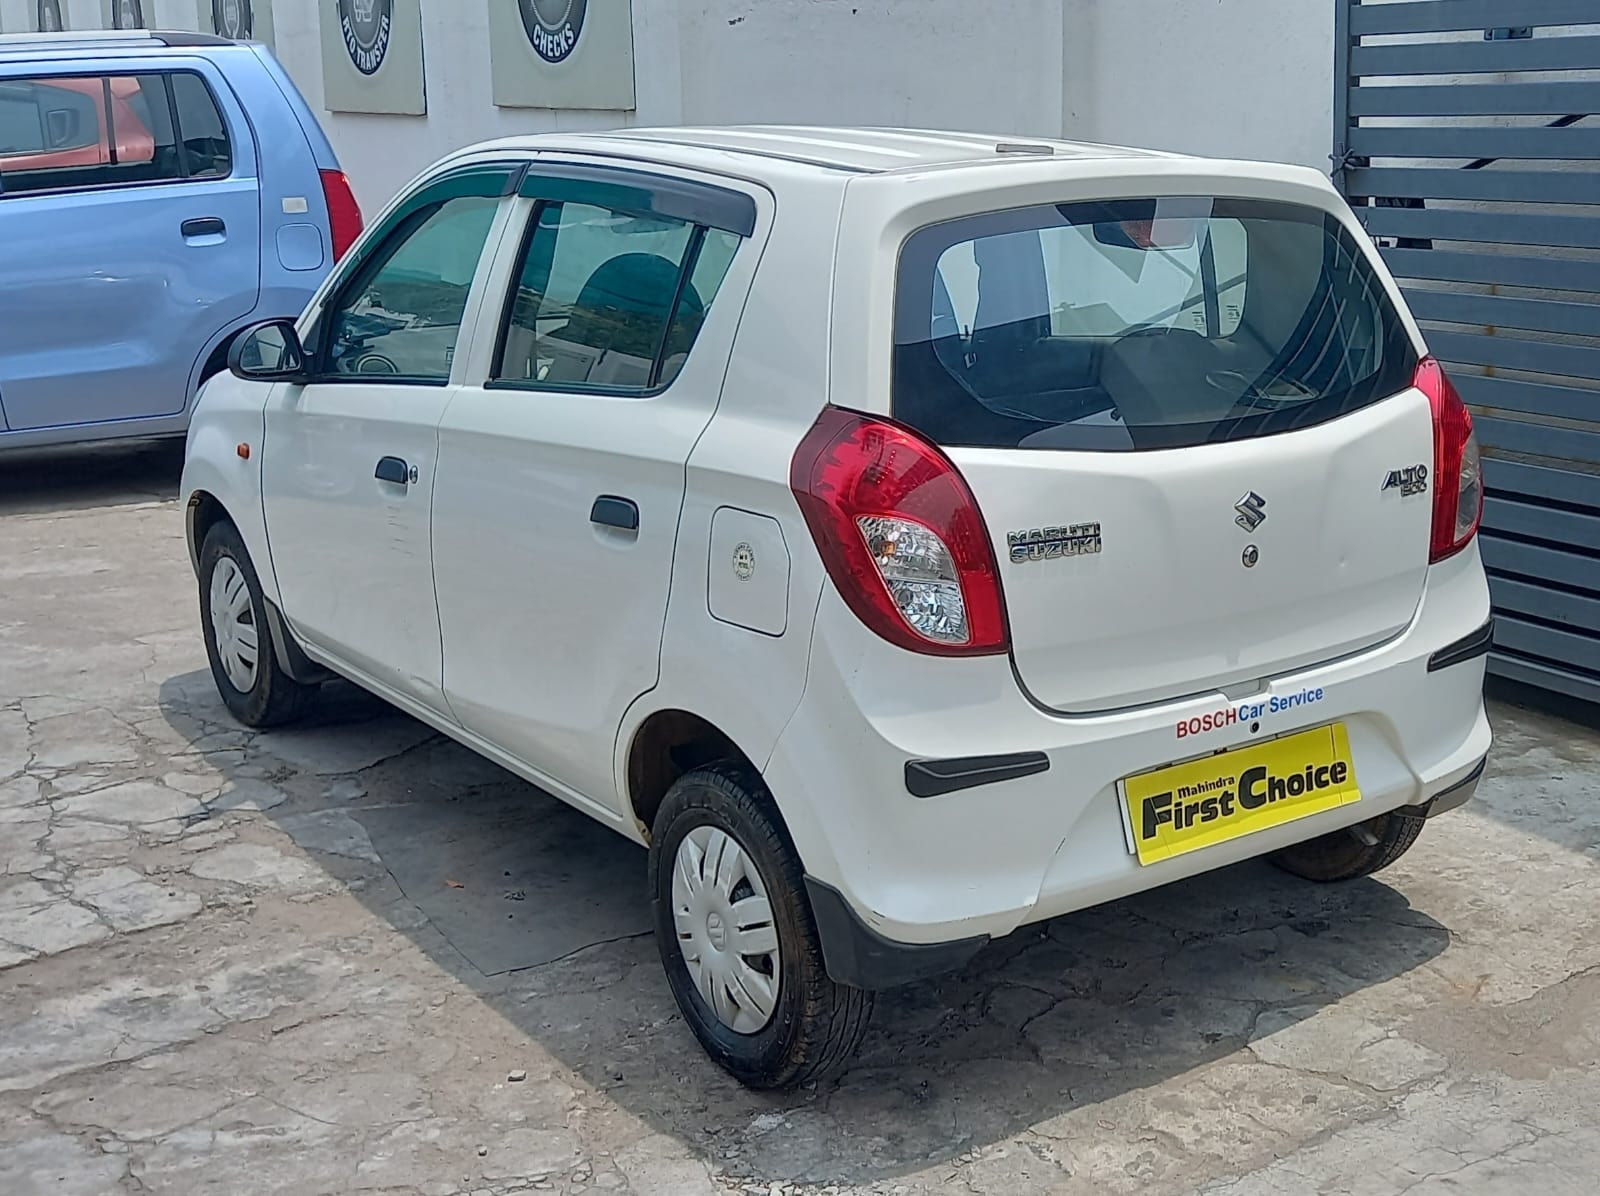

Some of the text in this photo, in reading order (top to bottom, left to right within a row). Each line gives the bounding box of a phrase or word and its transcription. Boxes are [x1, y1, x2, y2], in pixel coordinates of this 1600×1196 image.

[343, 15, 389, 70] RTO TRANSFER
[533, 23, 574, 57] CHECKS
[1381, 464, 1427, 490] ALTO
[1007, 522, 1101, 545] MARUTI
[1010, 537, 1102, 564] SUZUKI
[1176, 688, 1323, 738] BOSCH Car Service
[1142, 761, 1347, 840] First Choice
